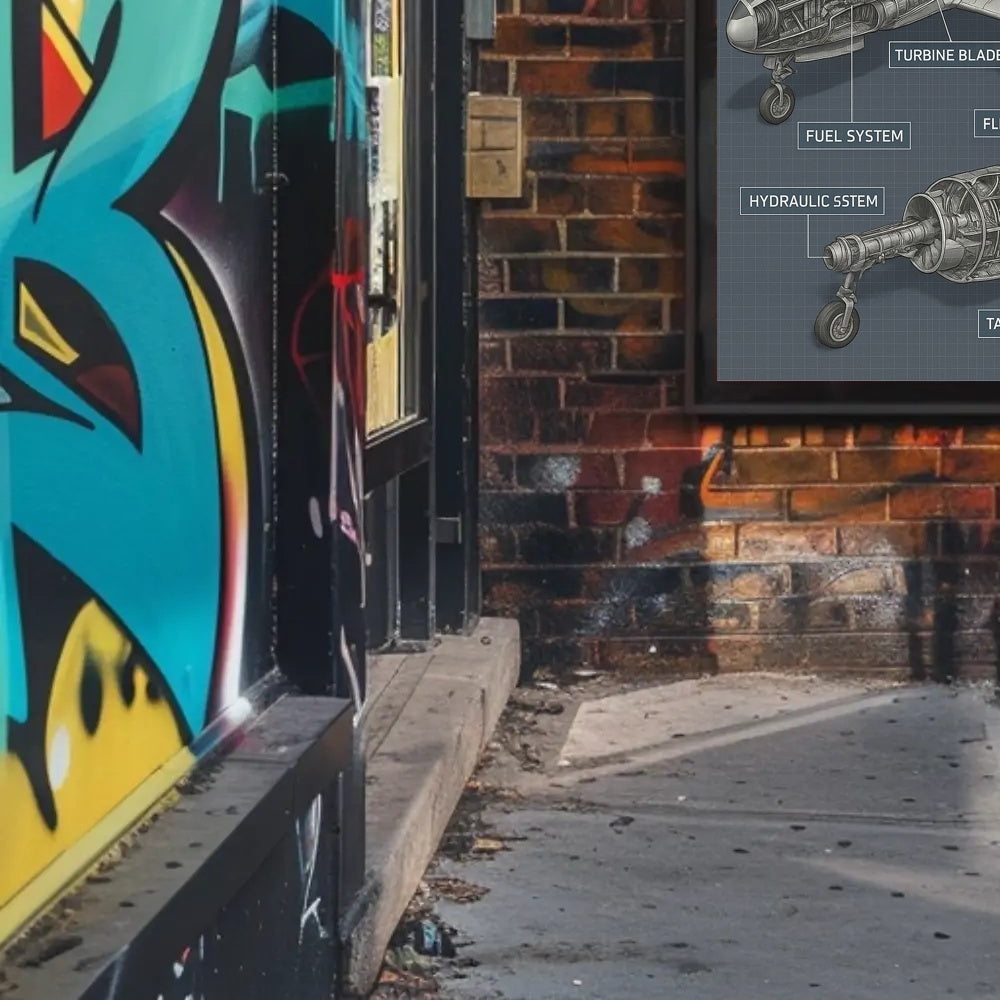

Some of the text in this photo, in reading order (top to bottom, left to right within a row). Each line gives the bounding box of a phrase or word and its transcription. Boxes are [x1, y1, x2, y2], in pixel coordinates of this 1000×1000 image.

[894, 49, 955, 62] TURBINE
[806, 129, 904, 143] FUEL SYSTEM
[749, 194, 878, 208] HYDRAULIC SSTEM
